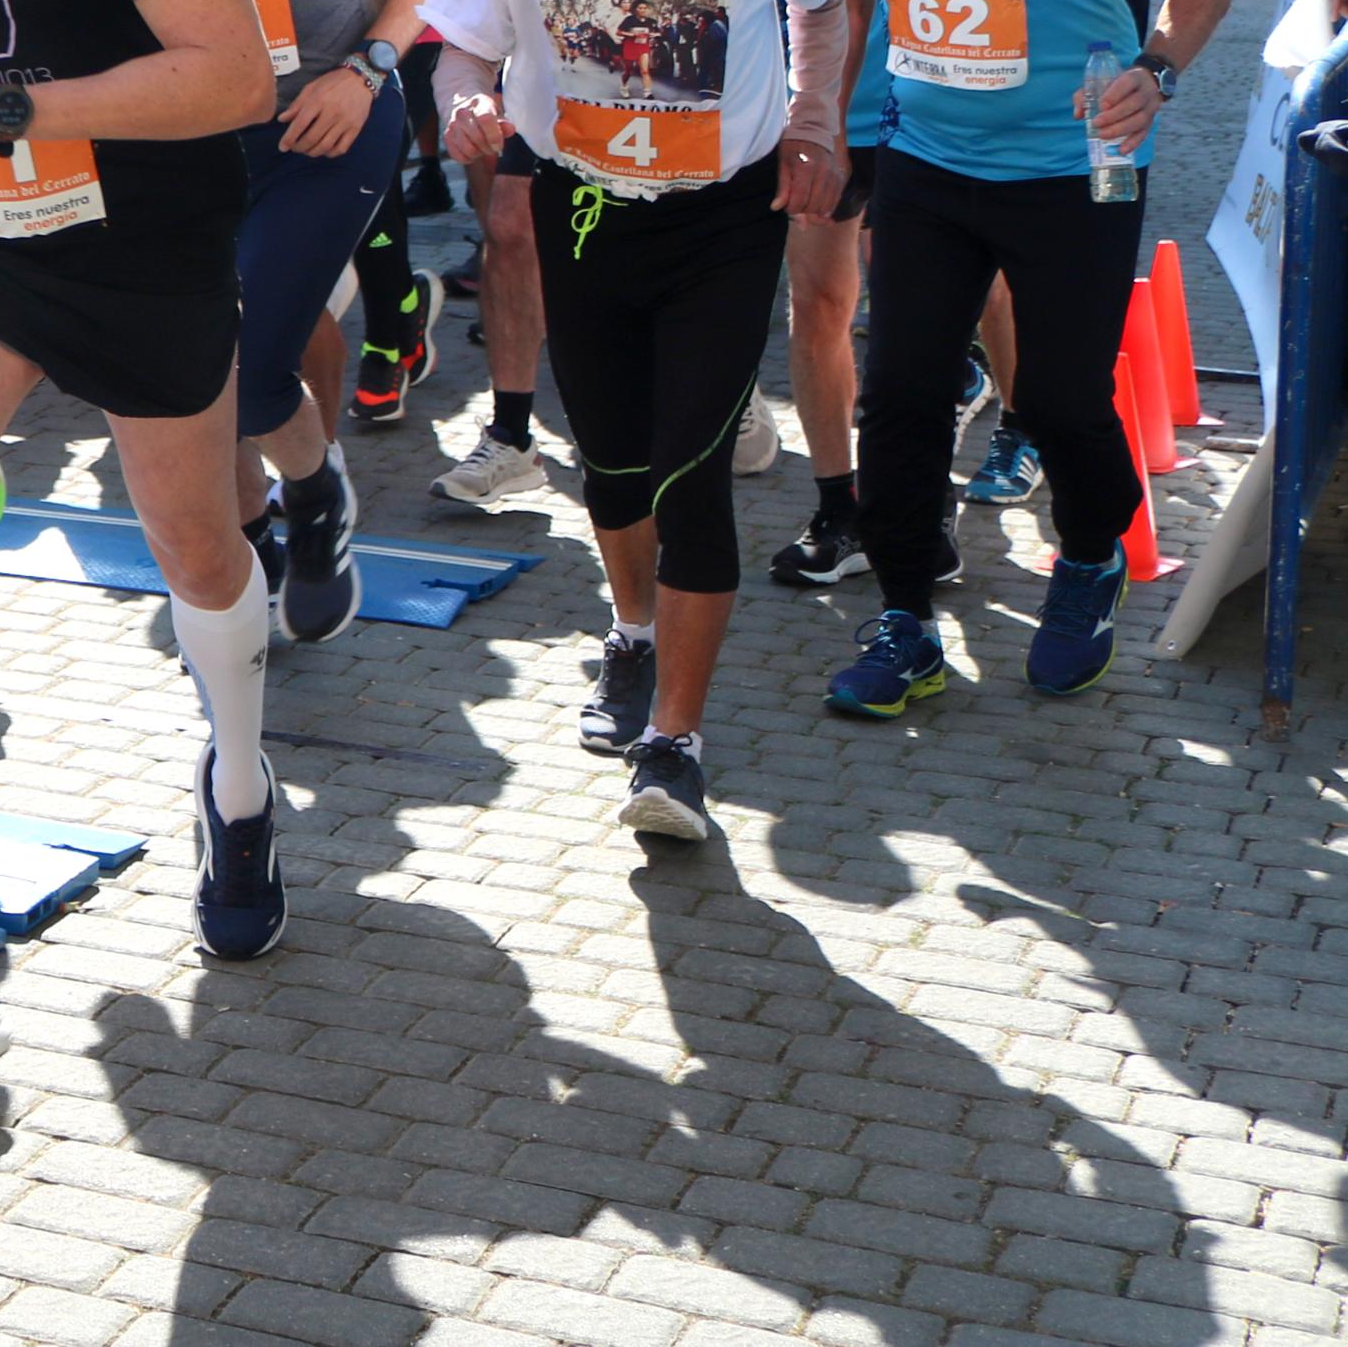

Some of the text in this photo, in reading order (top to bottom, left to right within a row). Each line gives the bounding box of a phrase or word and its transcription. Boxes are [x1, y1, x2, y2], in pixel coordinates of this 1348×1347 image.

[984, 48, 1022, 58] Cerrato
[953, 63, 973, 75] Eres
[975, 65, 1019, 76] nuestra
[607, 116, 658, 167] 4
[657, 170, 672, 179] del
[20, 184, 40, 197] del
[42, 172, 90, 192] Cerrato
[4, 208, 33, 223] Eres
[35, 195, 90, 217] nuestra
